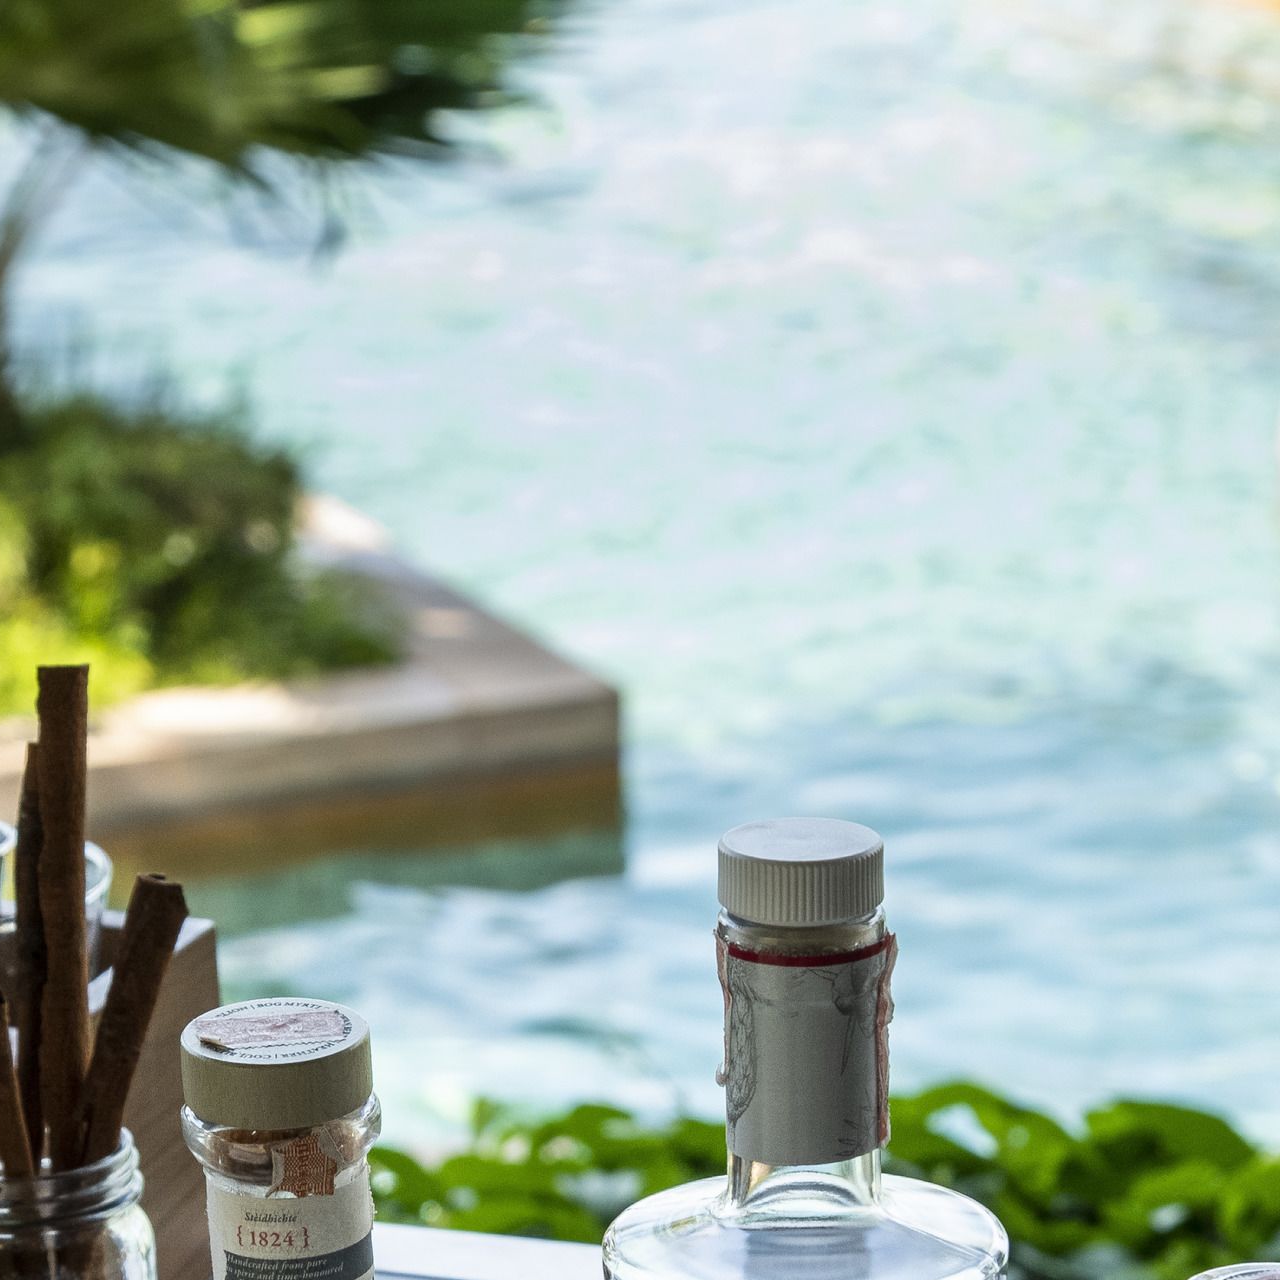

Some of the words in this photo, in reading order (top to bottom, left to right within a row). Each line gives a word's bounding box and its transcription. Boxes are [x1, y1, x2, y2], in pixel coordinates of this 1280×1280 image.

[249, 1230, 294, 1247] 1824
[226, 1253, 278, 1271] Handcrafted
[280, 1260, 304, 1271] from
[256, 1271, 275, 1280] and
